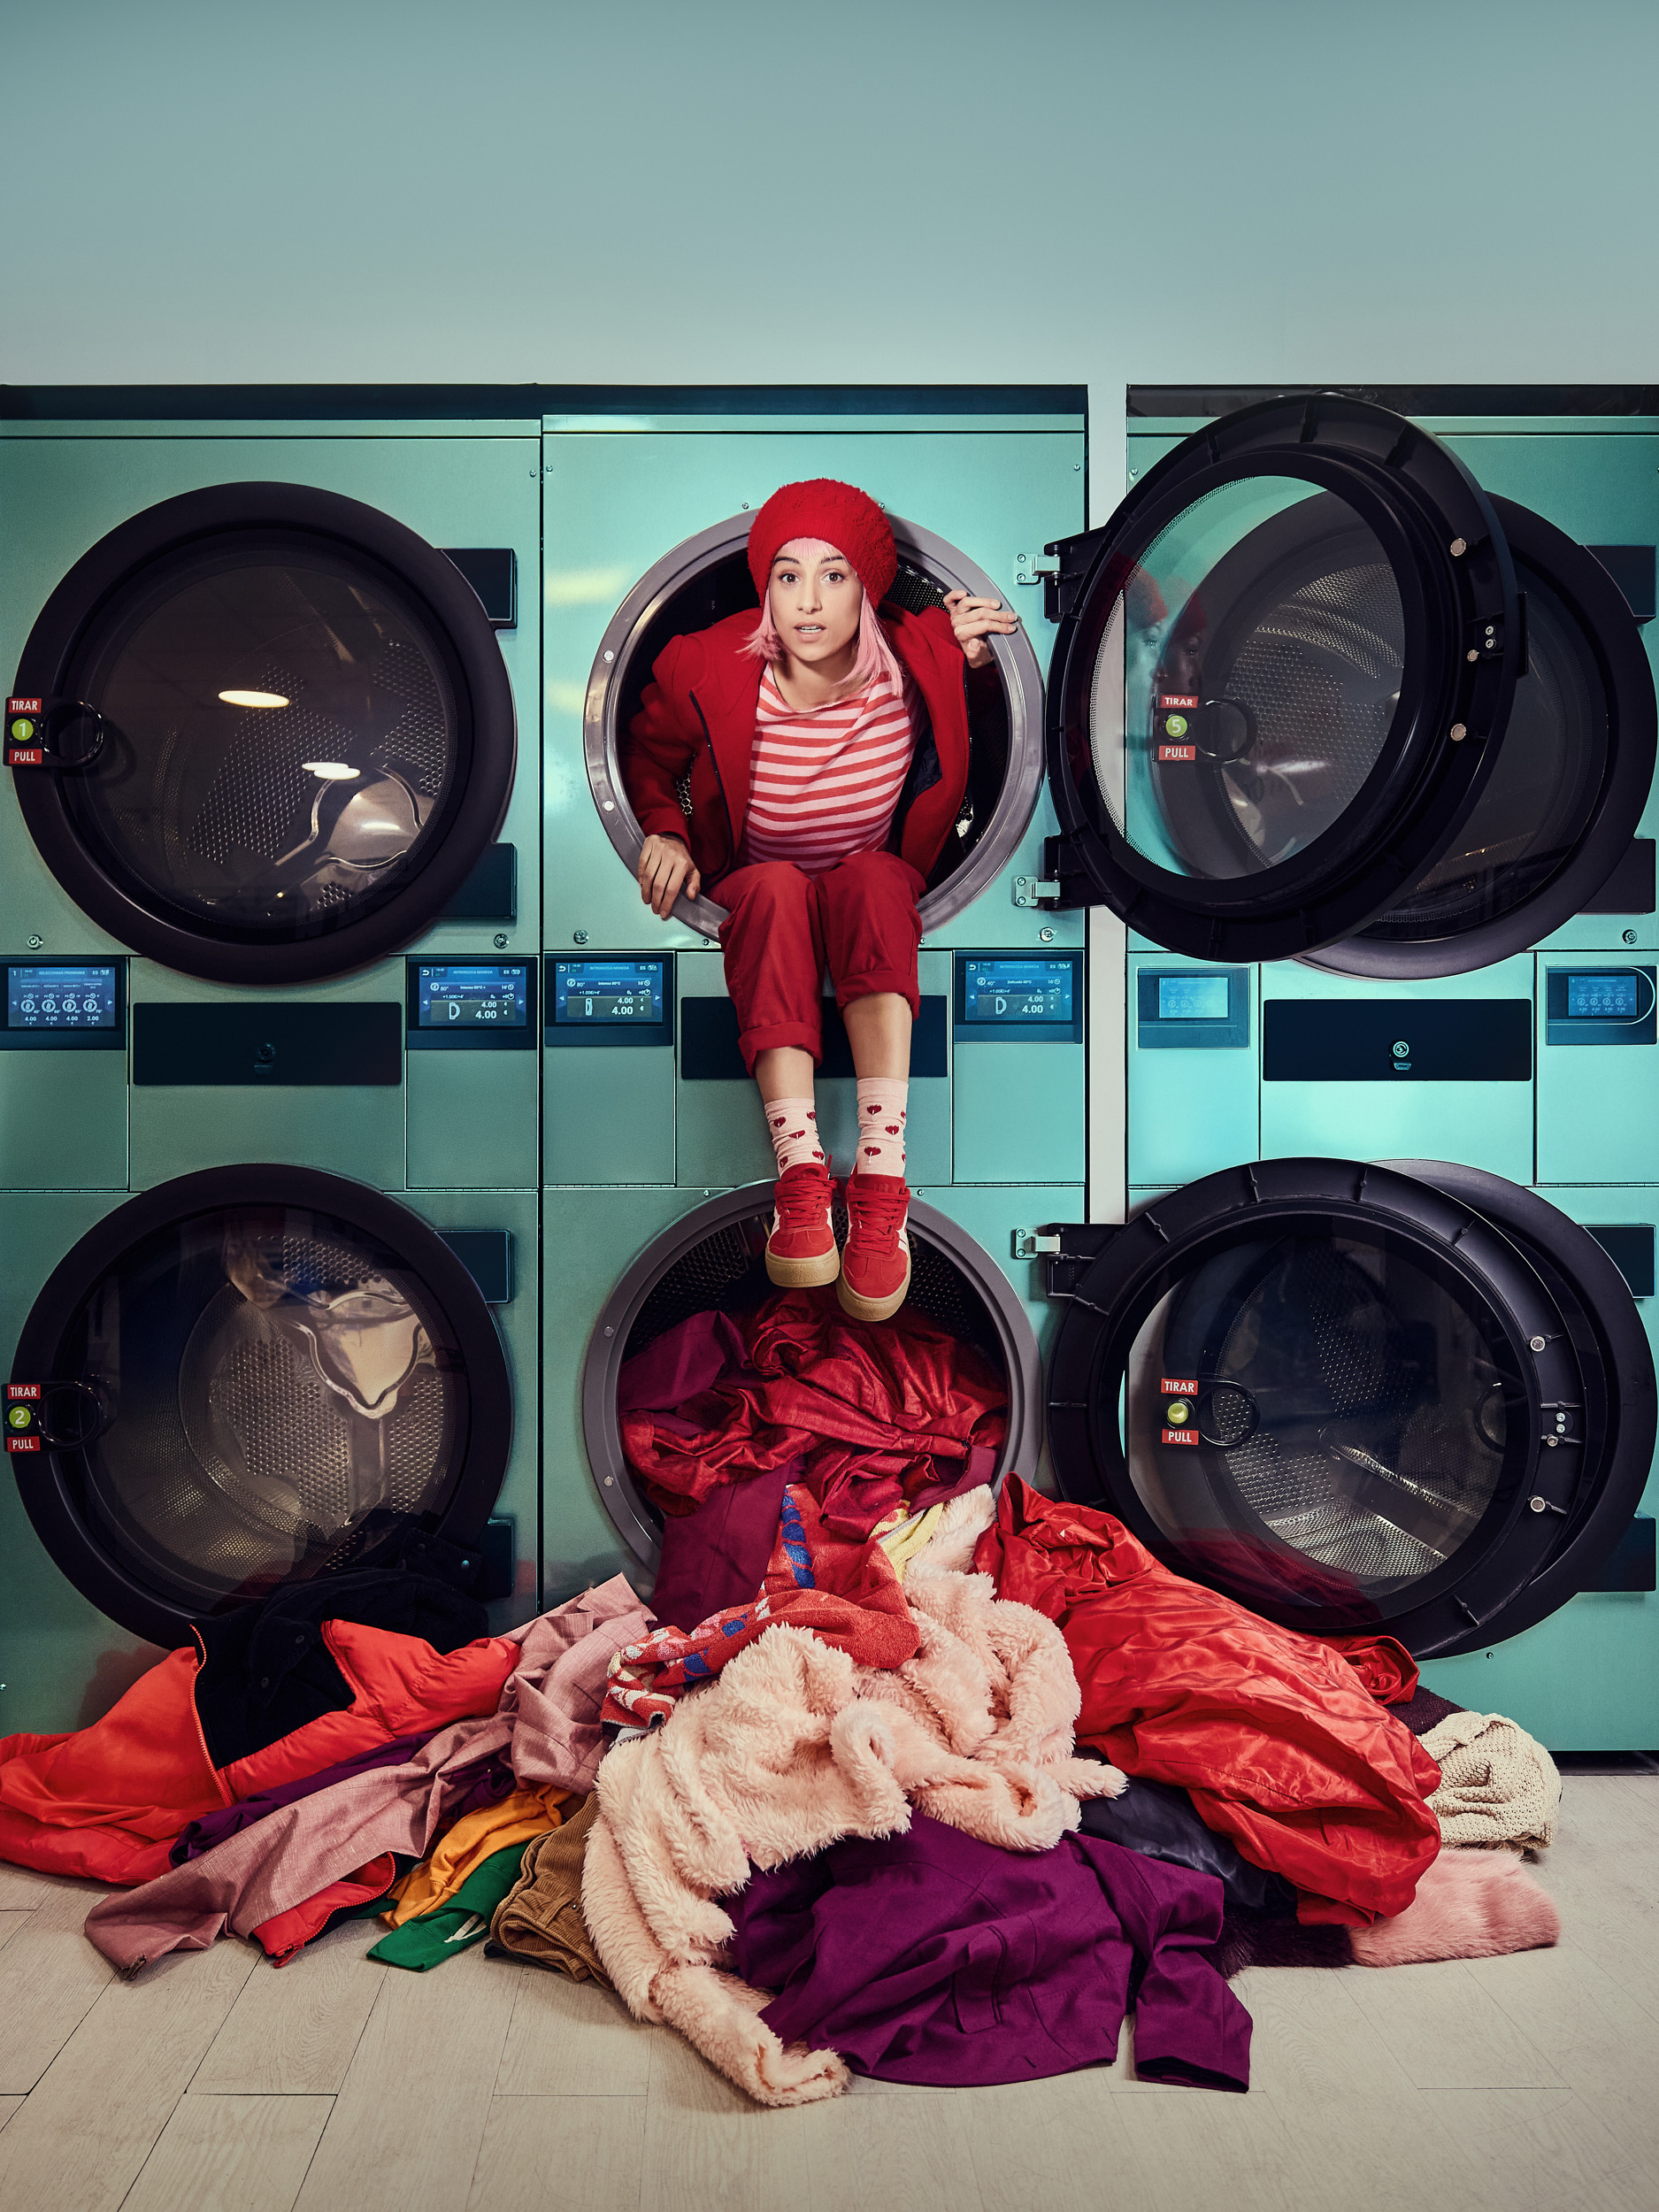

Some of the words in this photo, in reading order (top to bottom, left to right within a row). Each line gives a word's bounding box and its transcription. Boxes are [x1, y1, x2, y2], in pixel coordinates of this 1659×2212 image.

[12, 700, 38, 710] TIRAR
[1164, 697, 1193, 706] TIRAR
[19, 722, 26, 736] 1
[1172, 719, 1181, 733] 5
[14, 751, 35, 762] PULL
[1164, 748, 1189, 758] PULL
[475, 1010, 497, 1019] 4.00
[611, 1006, 634, 1015] 4.00
[1021, 1004, 1044, 1014] 4.00
[10, 1386, 37, 1397] TIRAR
[1164, 1381, 1194, 1393] TIRAR
[15, 1410, 25, 1424] 2
[1168, 1431, 1192, 1443] PULL
[12, 1439, 34, 1450] PULL
